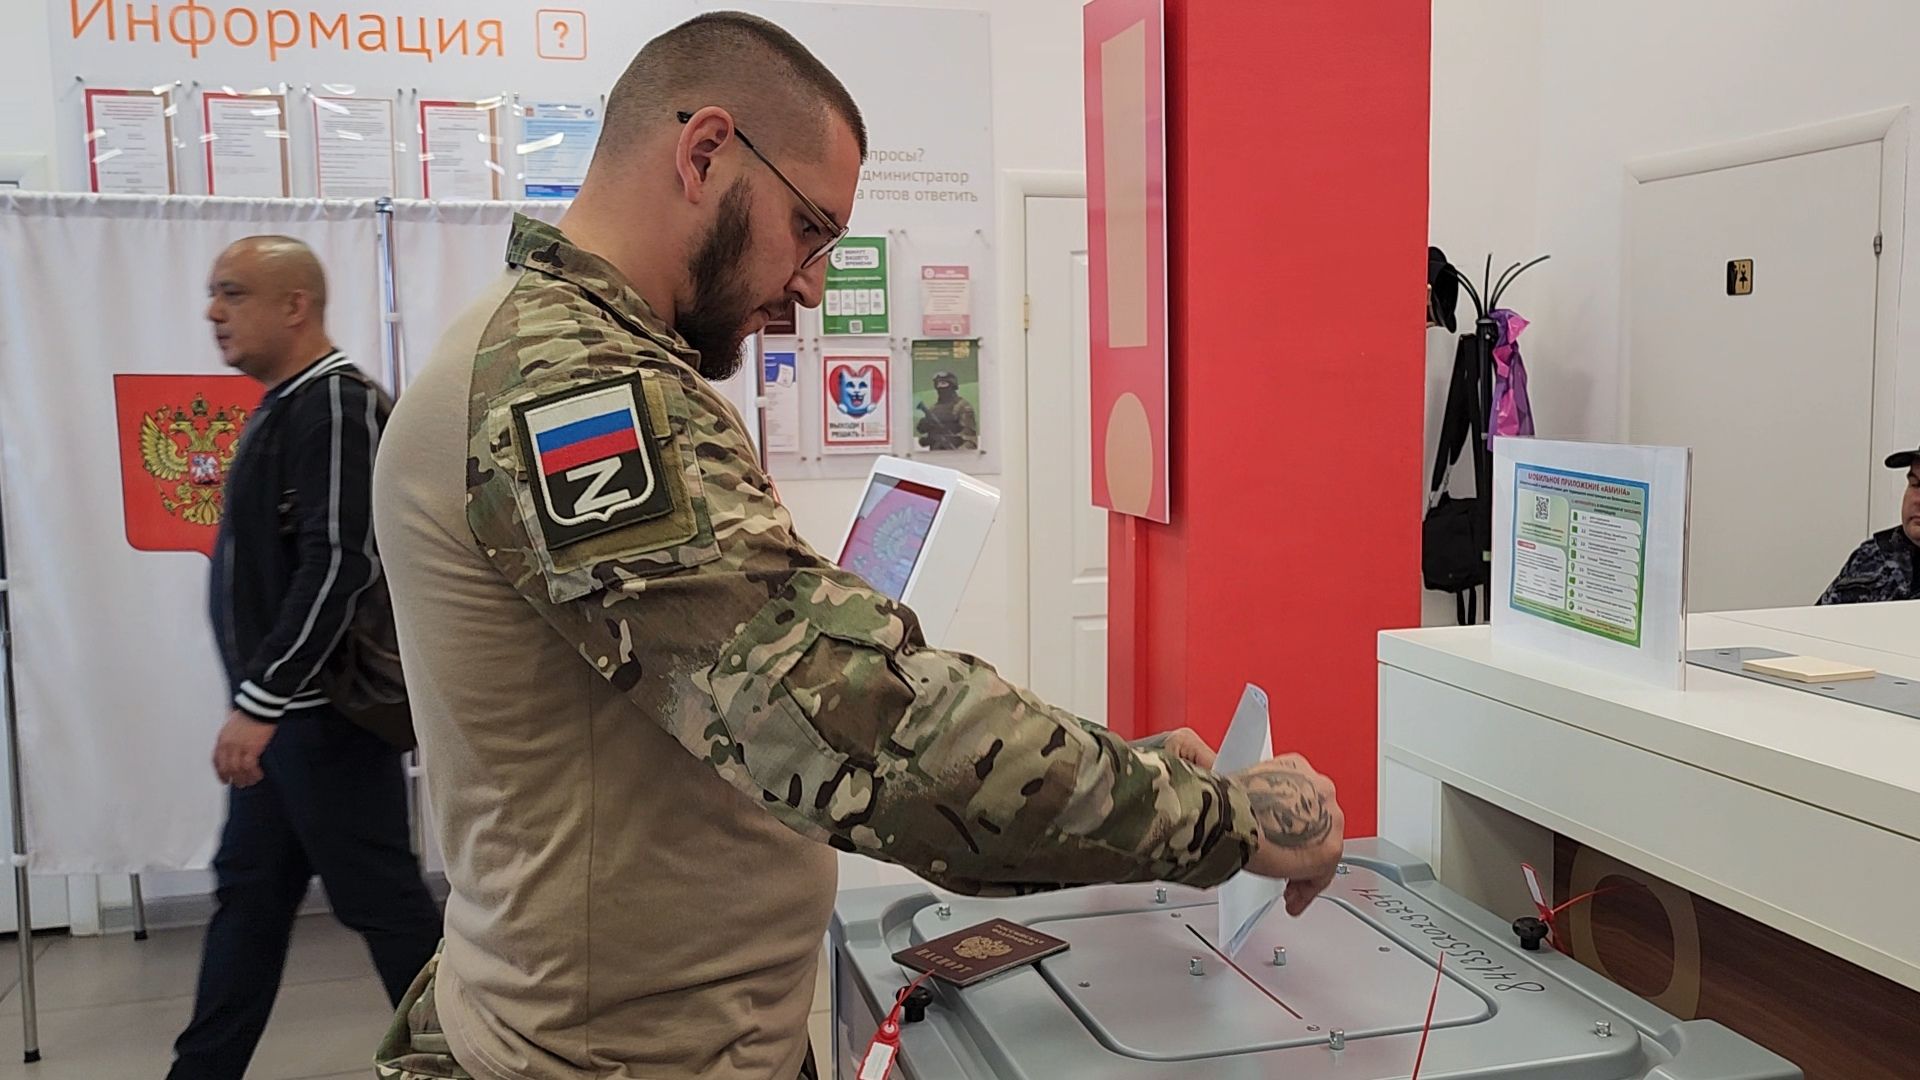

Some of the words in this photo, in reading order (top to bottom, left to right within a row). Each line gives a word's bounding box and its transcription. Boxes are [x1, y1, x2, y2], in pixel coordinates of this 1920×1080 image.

[69, 0, 504, 63] Информация
[867, 148, 925, 164] просы?
[861, 170, 969, 185] дминистратор
[870, 189, 909, 200] готов
[914, 190, 978, 202] ответить
[834, 253, 842, 262] 5
[565, 456, 631, 515] Z
[1528, 472, 1560, 485] МОБИЛЬНОЕ
[1560, 478, 1600, 491] ПРИЛОЖЕНИЕ
